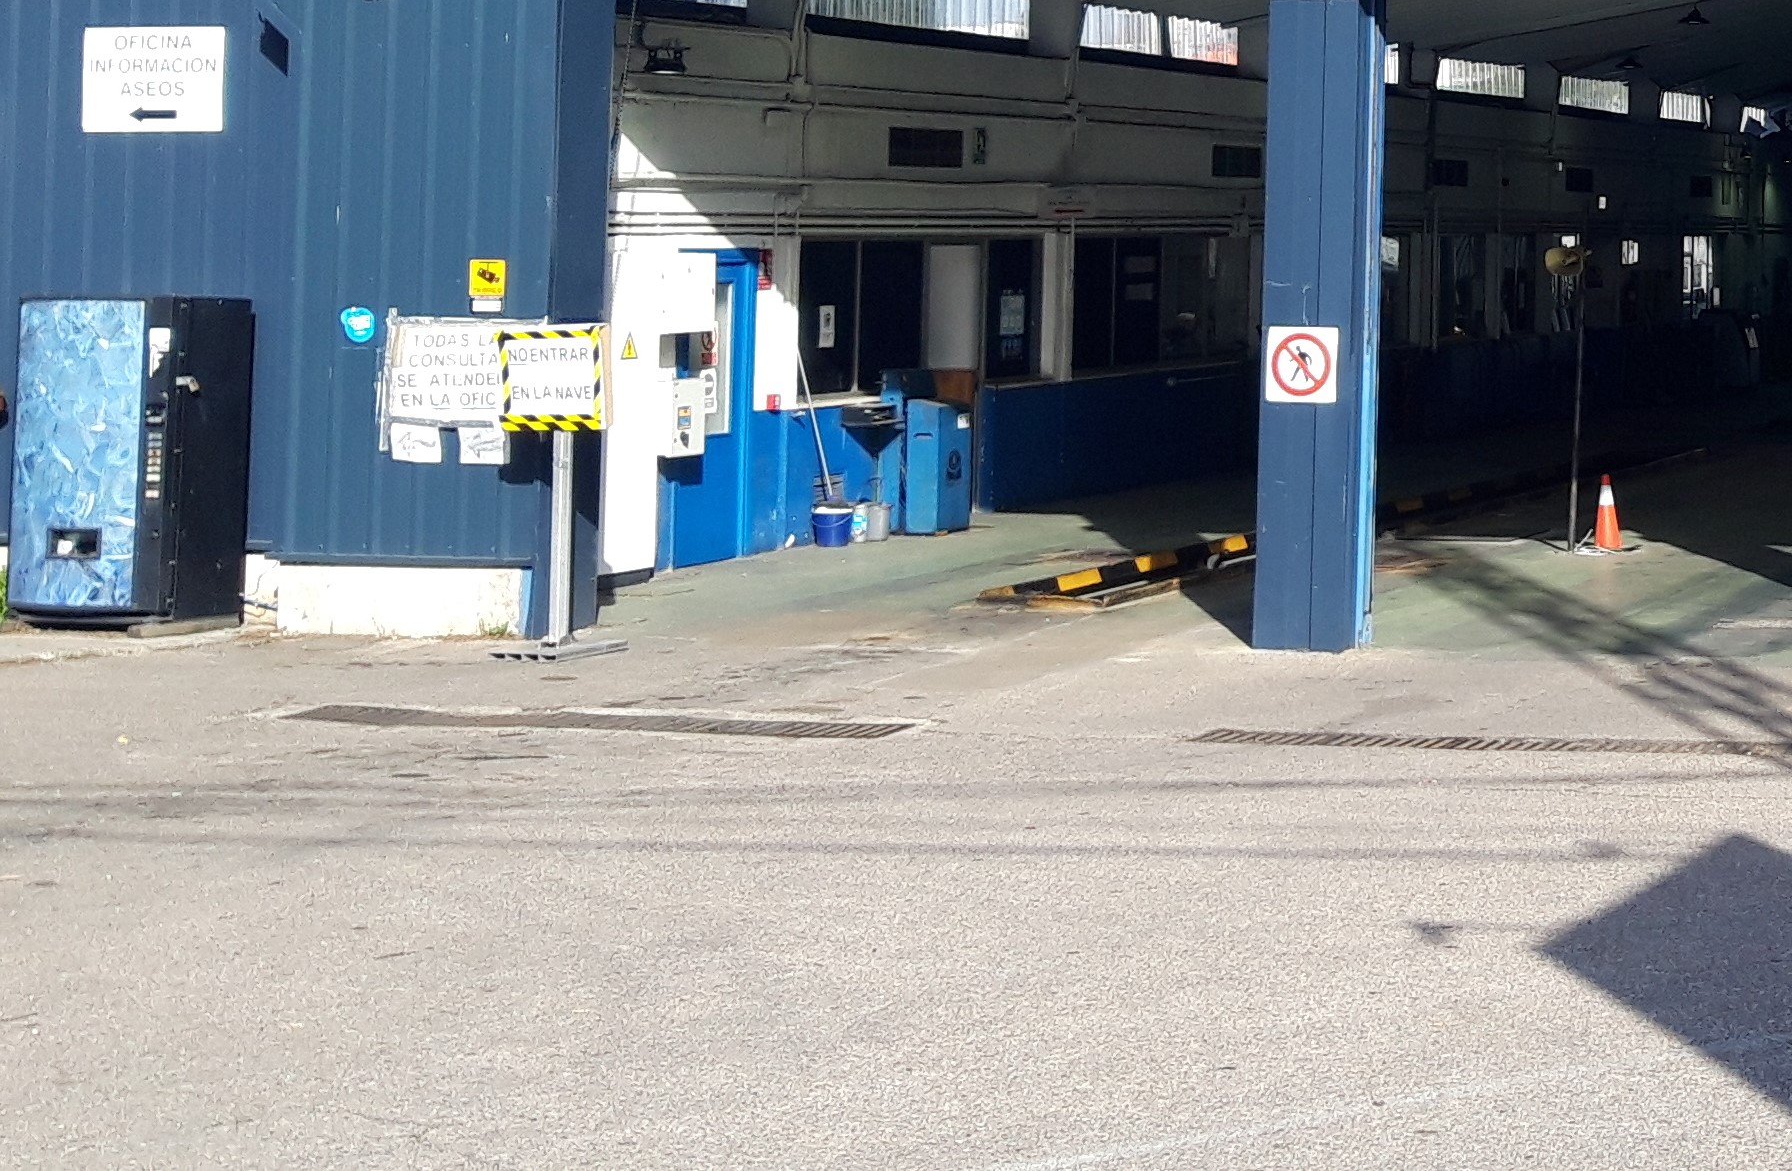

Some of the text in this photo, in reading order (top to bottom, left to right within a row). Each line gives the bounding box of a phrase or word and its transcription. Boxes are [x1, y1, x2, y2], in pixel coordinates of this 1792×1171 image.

[115, 34, 192, 50] OFICINA
[90, 57, 217, 74] INFORMACION
[121, 81, 185, 97] ASEOS
[413, 333, 469, 348] TODAS
[530, 347, 589, 362] ENTRAR
[397, 373, 418, 388] SE
[512, 385, 592, 400] EN LA NAVE
[400, 393, 423, 408] EN
[430, 393, 451, 407] LA
